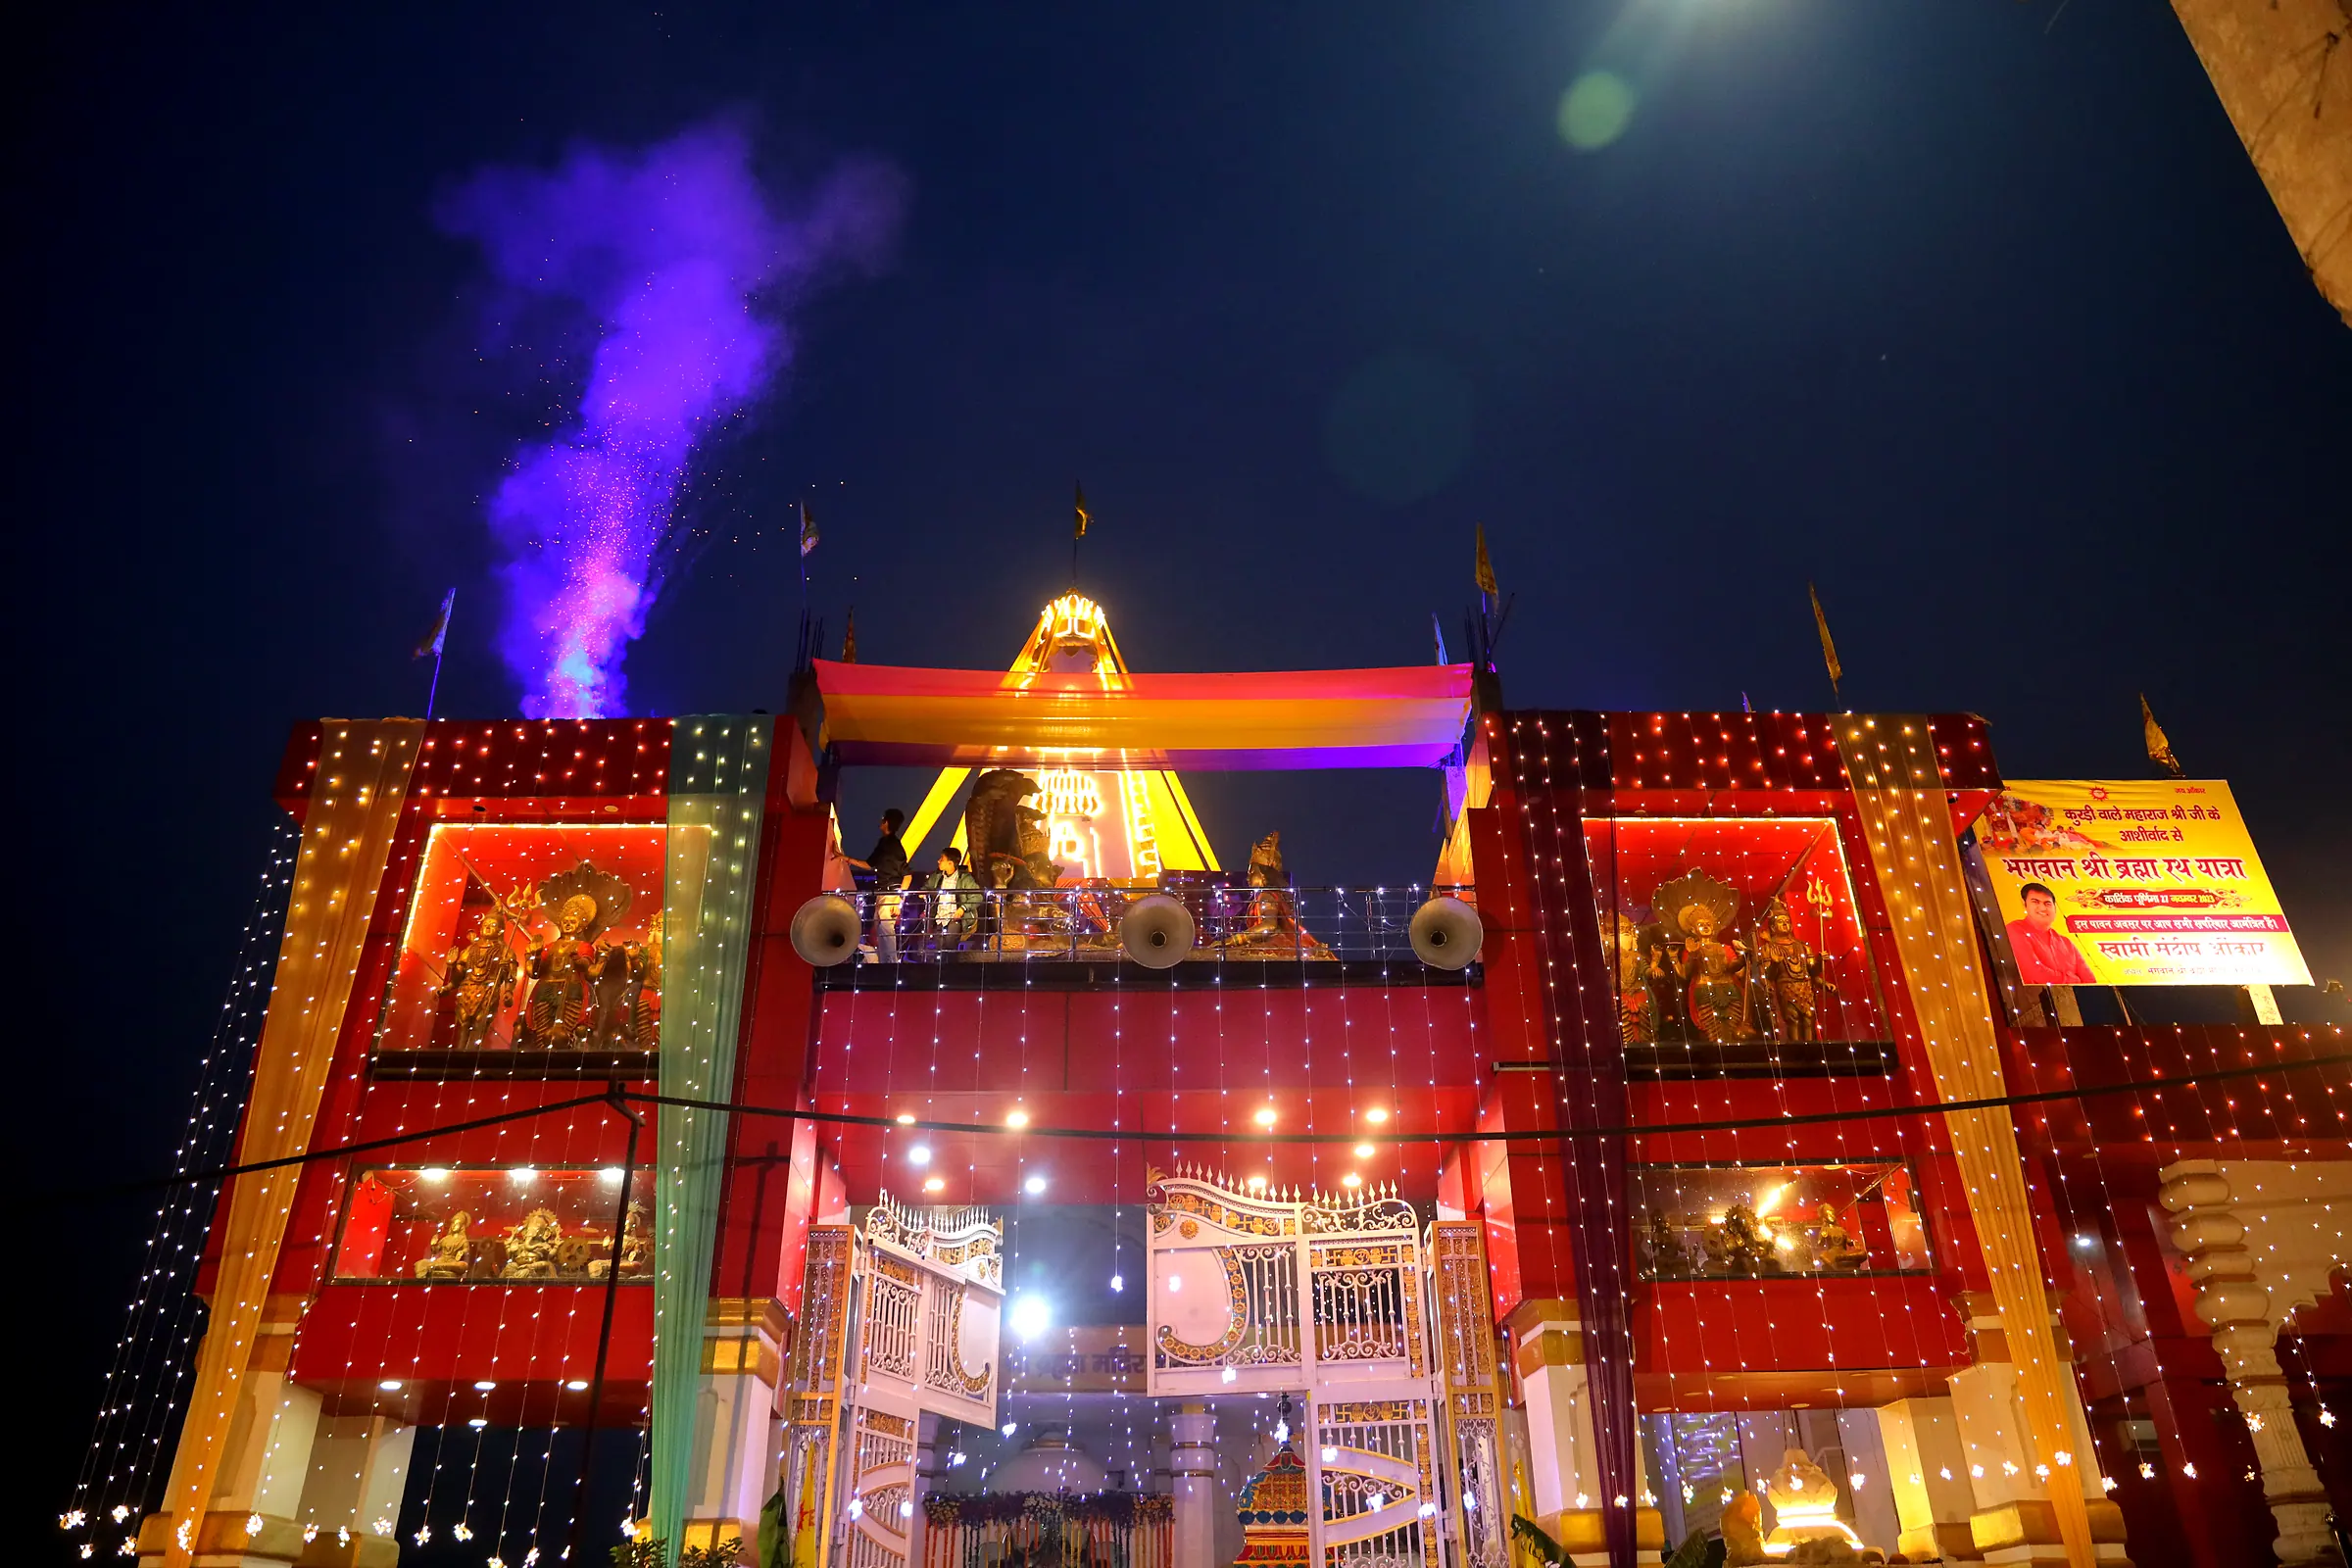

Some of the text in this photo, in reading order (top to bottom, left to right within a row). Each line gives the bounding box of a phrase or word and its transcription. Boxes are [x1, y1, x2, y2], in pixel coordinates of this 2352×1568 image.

[2097, 805, 2122, 821] वाले
[2124, 808, 2169, 821] महाराज
[2171, 804, 2186, 820] श्री
[2187, 804, 2206, 820] जी
[2206, 806, 2221, 820] के
[2120, 825, 2183, 842] आशीर्वाद से
[2002, 851, 2247, 882] भगवान श्री ब्रह्मा रथ यात्रा
[2103, 892, 2133, 904] कार्तिक
[2133, 892, 2159, 906] पूर्णिमा
[2075, 918, 2089, 930] इस
[2089, 919, 2112, 929] पावन
[2113, 919, 2142, 931] अवसर
[2141, 919, 2154, 930] पर
[2154, 919, 2172, 929] आप
[2174, 916, 2193, 930] सभी
[2194, 916, 2230, 931] सपरिवार
[2230, 916, 2266, 930] आमंत्रित
[2097, 936, 2151, 959] स्वामी
